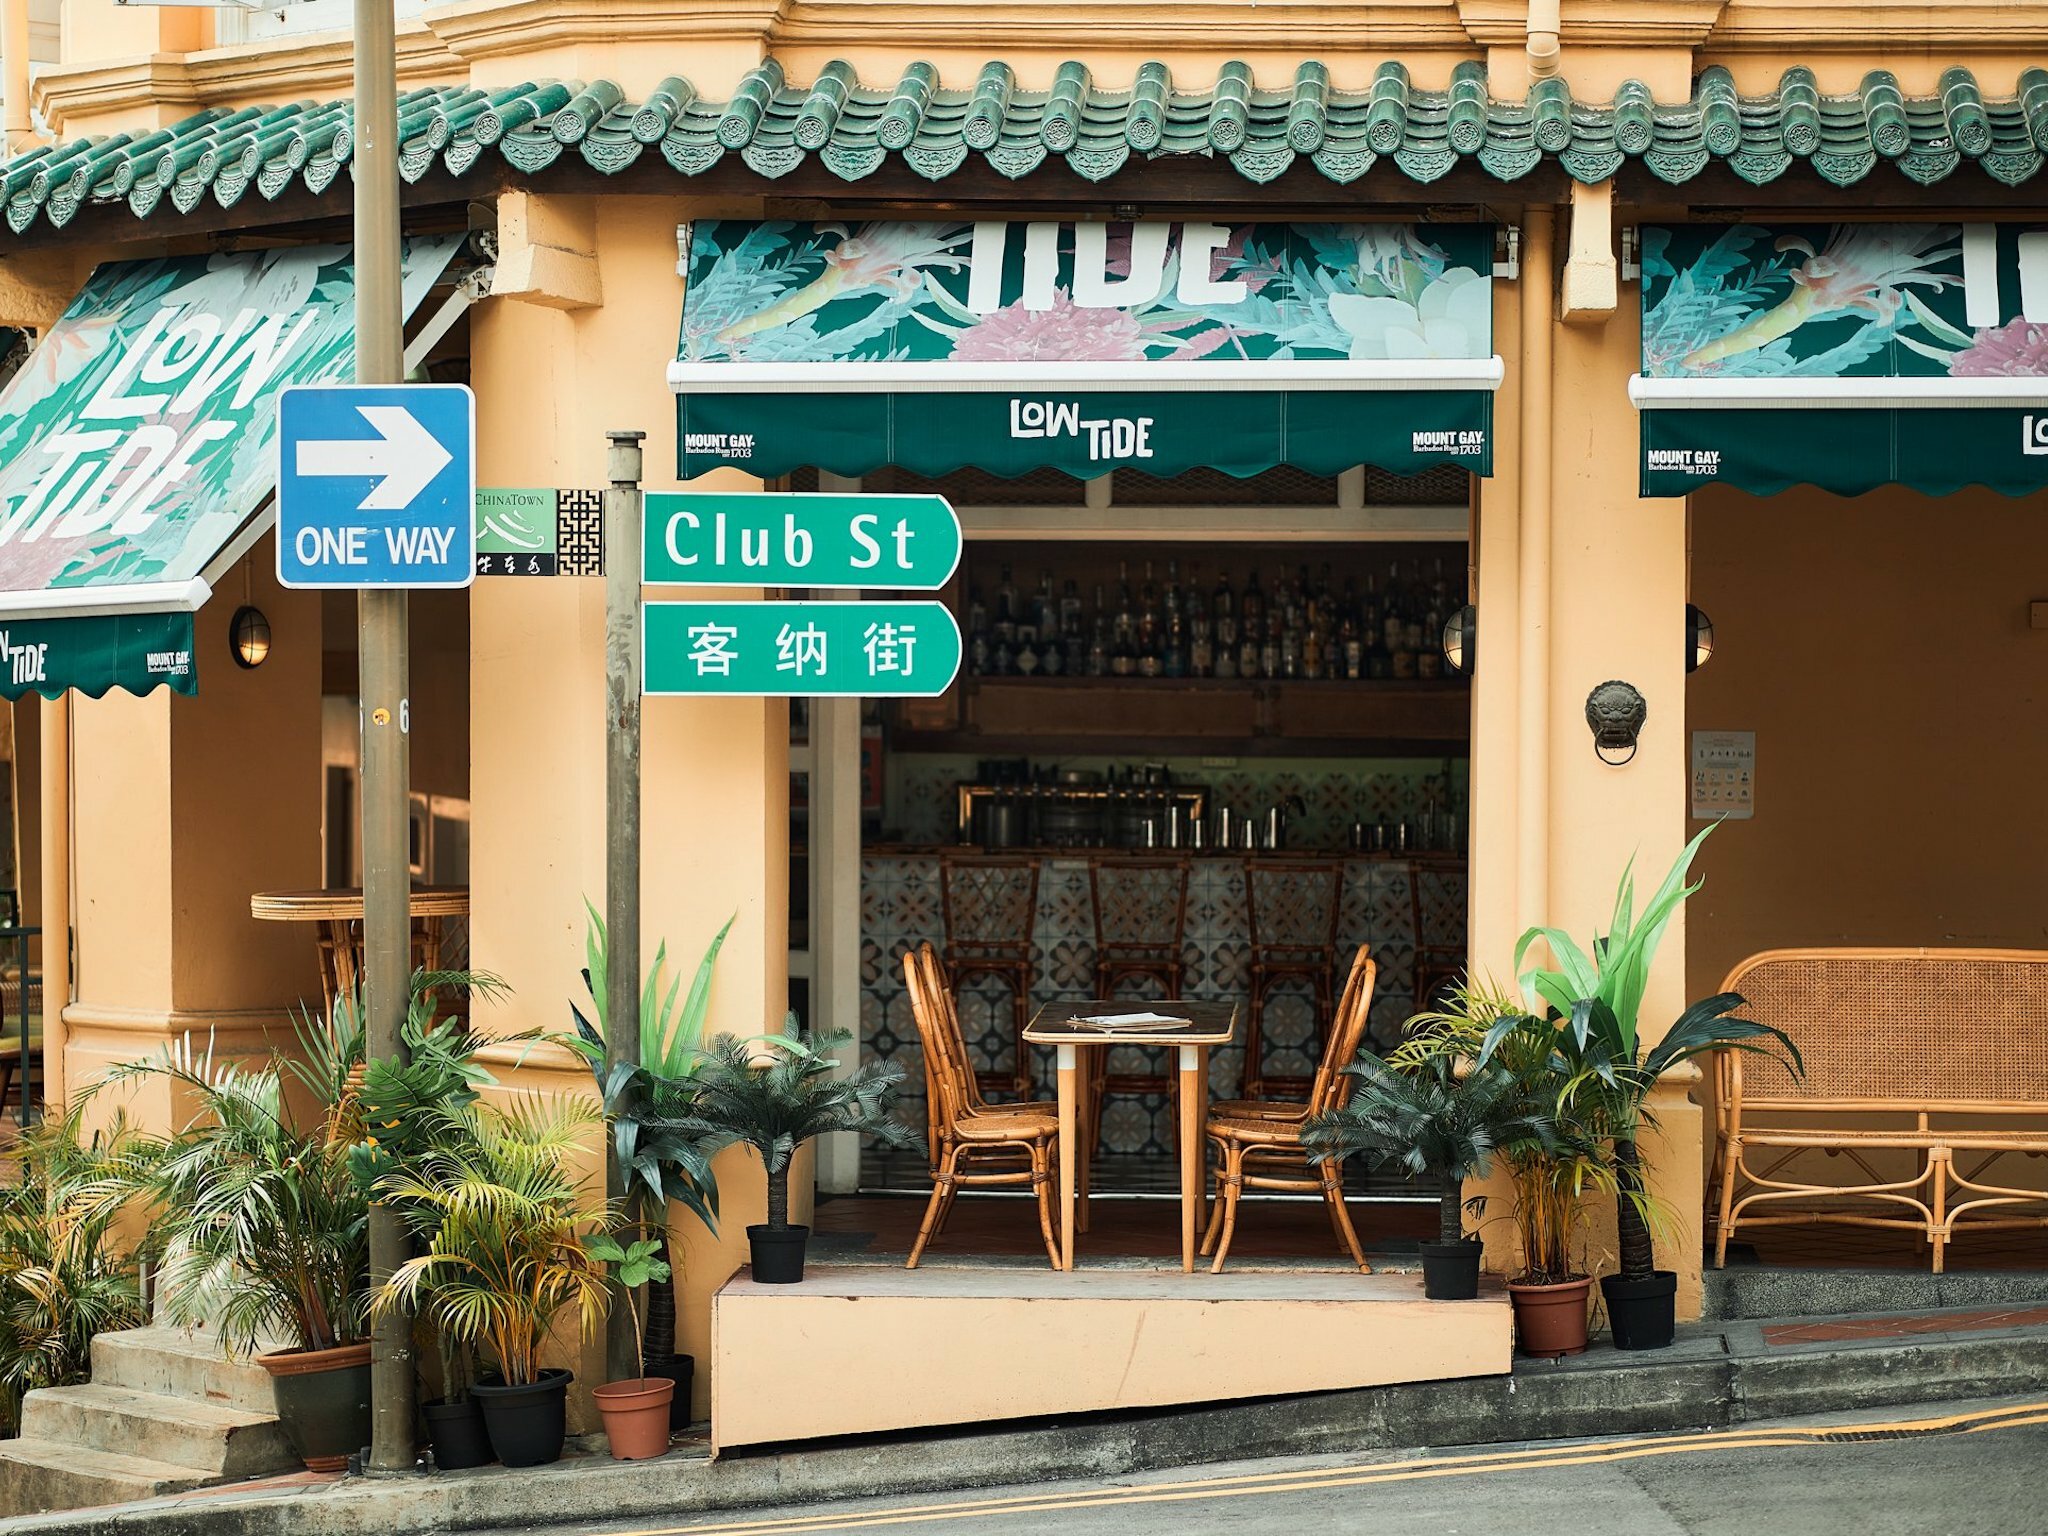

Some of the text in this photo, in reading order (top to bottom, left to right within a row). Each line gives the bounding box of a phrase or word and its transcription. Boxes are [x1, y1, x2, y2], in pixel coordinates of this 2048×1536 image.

[78, 306, 320, 420] LOW
[685, 434, 755, 448] MOUNT GAY
[1010, 399, 1154, 461] LOW TIDE
[1412, 431, 1484, 445] MOUNT GAY
[730, 448, 752, 458] 1703
[1459, 445, 1482, 455] 1703
[1647, 450, 1720, 464] MOUNT GAY
[0, 419, 239, 545] TIDE
[1695, 465, 1717, 475] 1703
[295, 526, 456, 566] ONE WAY
[665, 511, 915, 569] Club St
[8, 643, 49, 685] TIDE
[147, 652, 175, 667] MOUNT
[687, 622, 917, 677] 客纳街
[399, 698, 410, 734] 6
